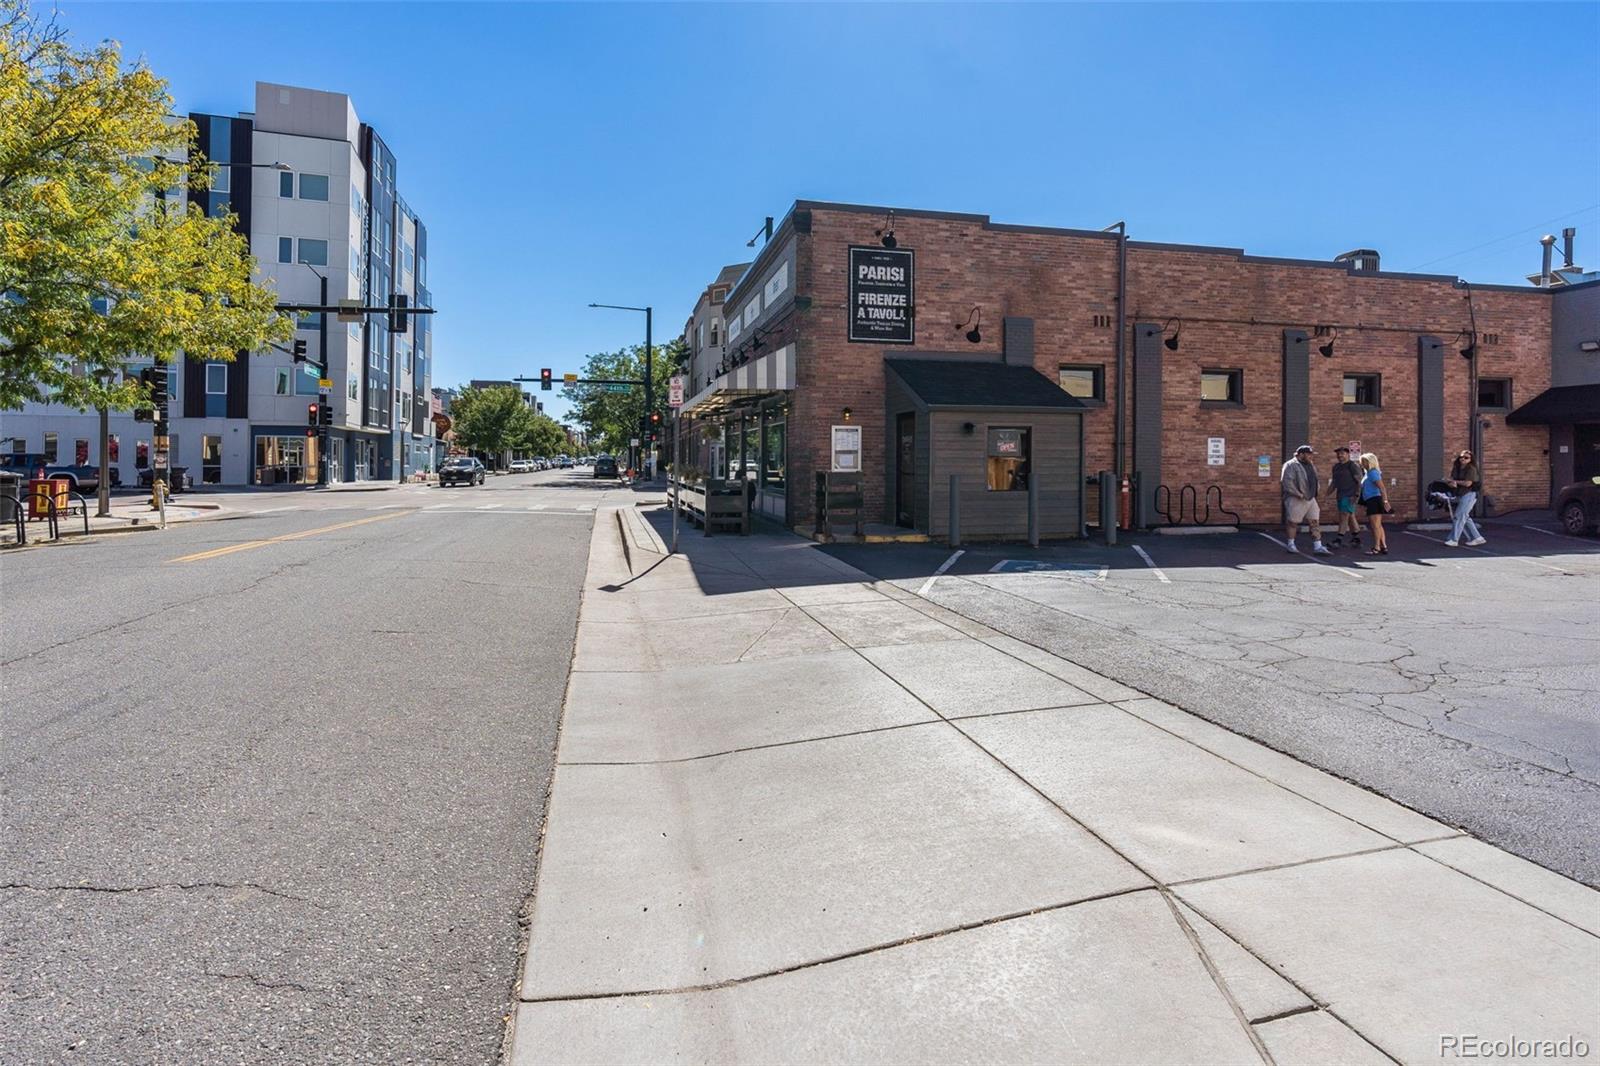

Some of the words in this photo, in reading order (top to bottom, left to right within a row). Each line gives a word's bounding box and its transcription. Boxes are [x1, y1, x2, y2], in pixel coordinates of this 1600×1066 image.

[859, 264, 904, 282] PARISI
[858, 292, 906, 306] FIRENZE
[857, 307, 866, 318] A
